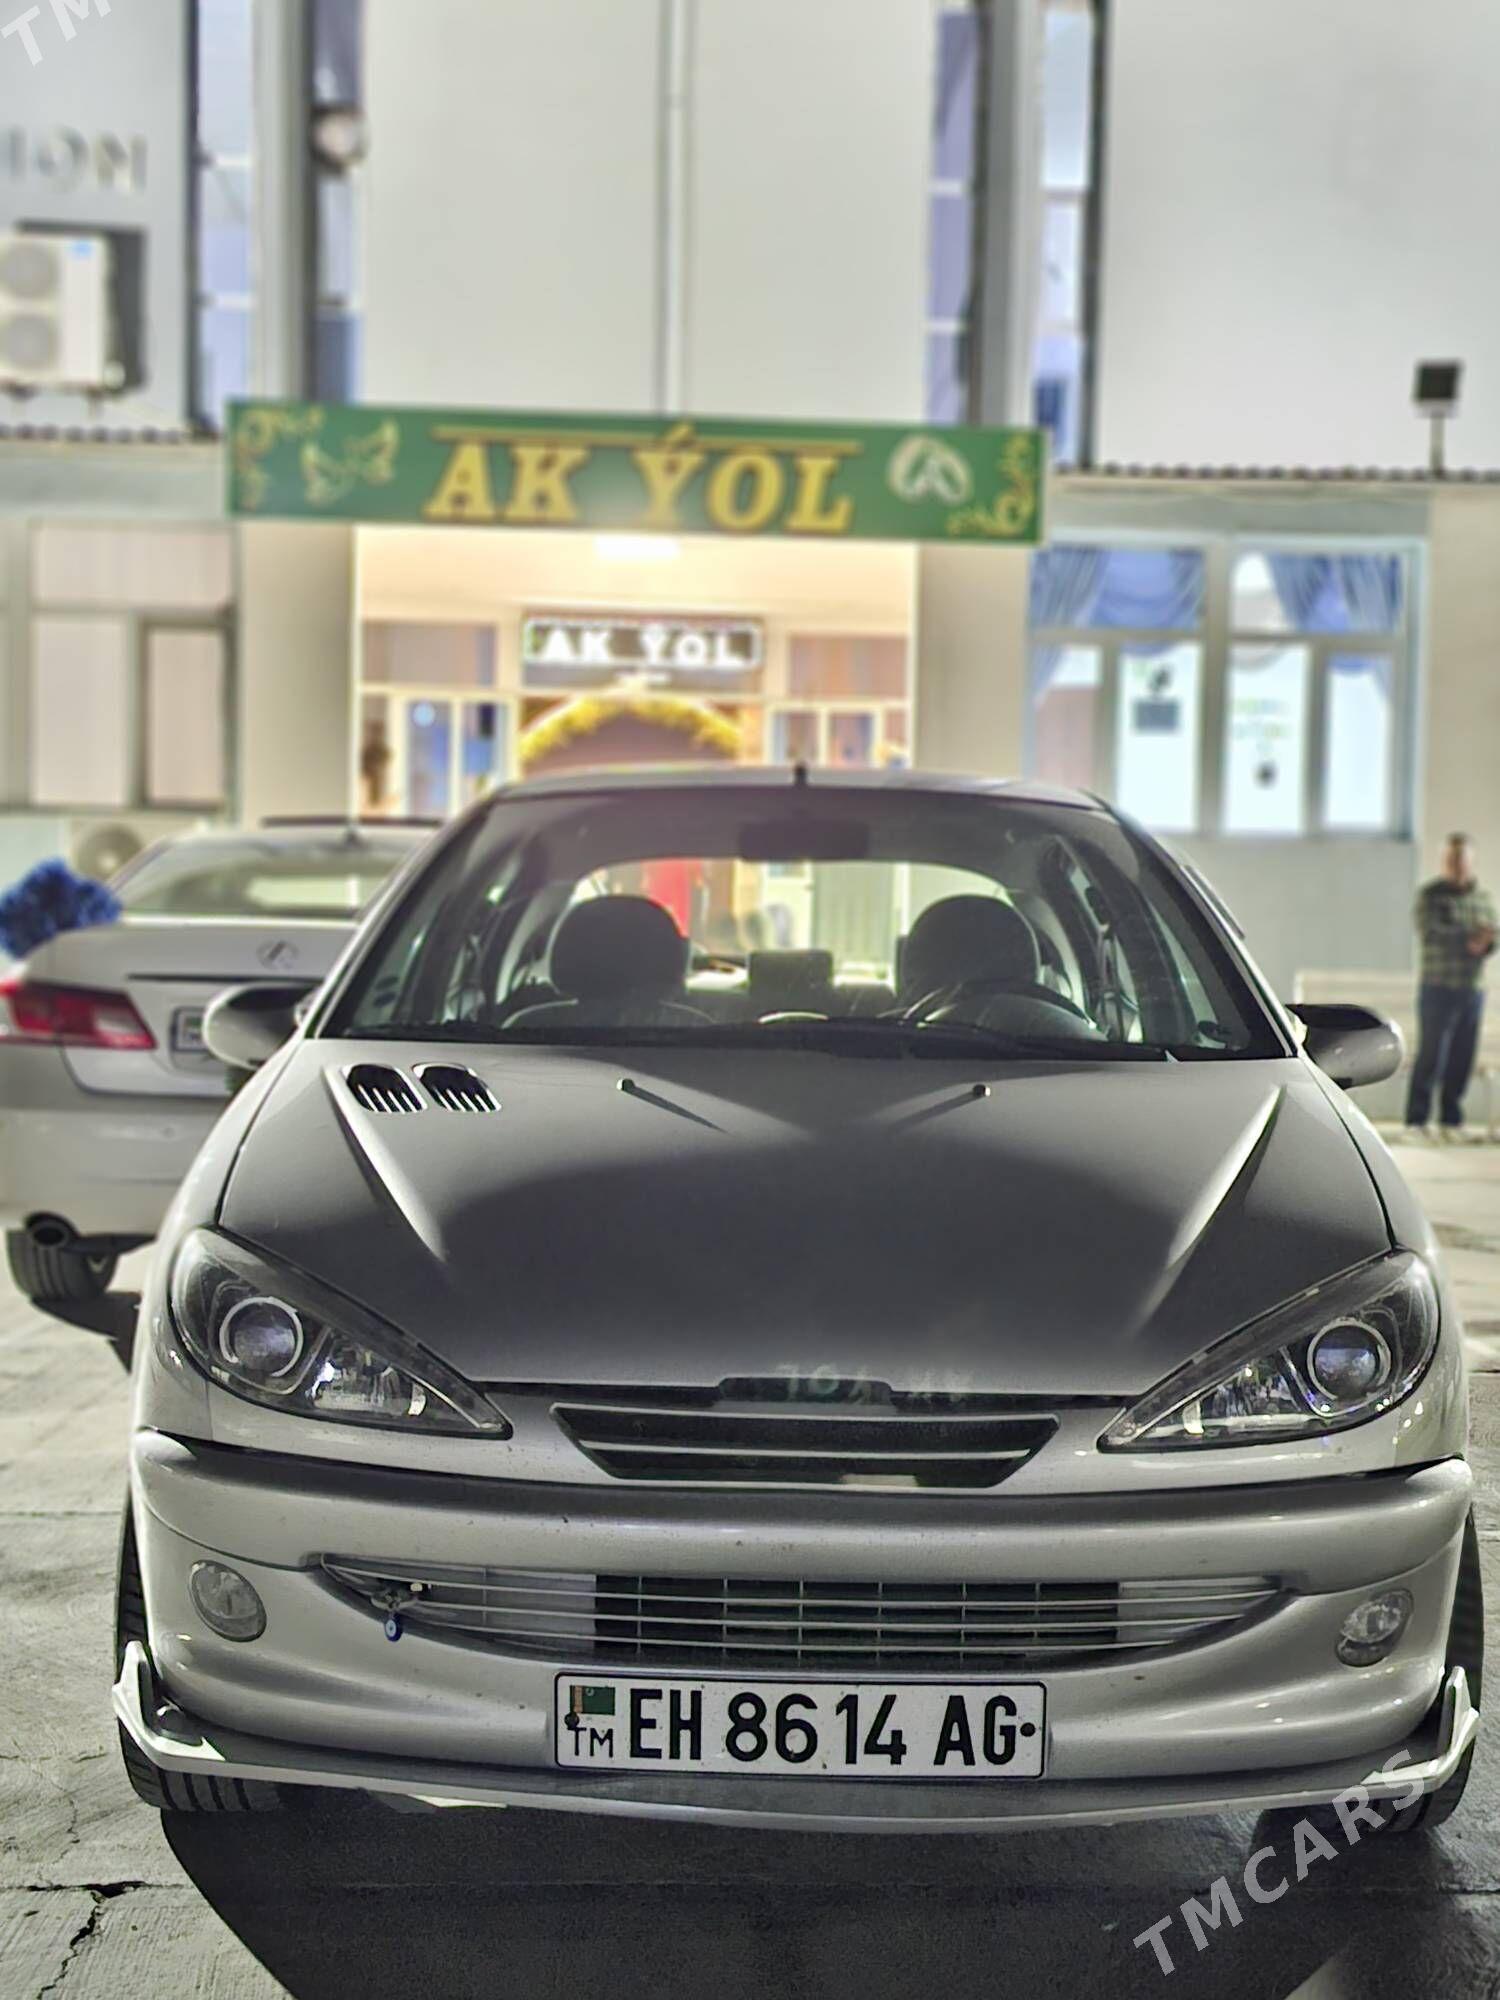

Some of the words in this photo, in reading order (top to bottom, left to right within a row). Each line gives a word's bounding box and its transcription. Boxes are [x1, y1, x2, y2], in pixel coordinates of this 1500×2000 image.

[424, 439, 590, 521] AK
[631, 422, 852, 534] ÝOL
[538, 627, 613, 663] AK
[568, 1727, 613, 1758] TM
[630, 1688, 703, 1760] EH
[726, 1692, 907, 1765] 8614
[934, 1695, 1017, 1766] AG
